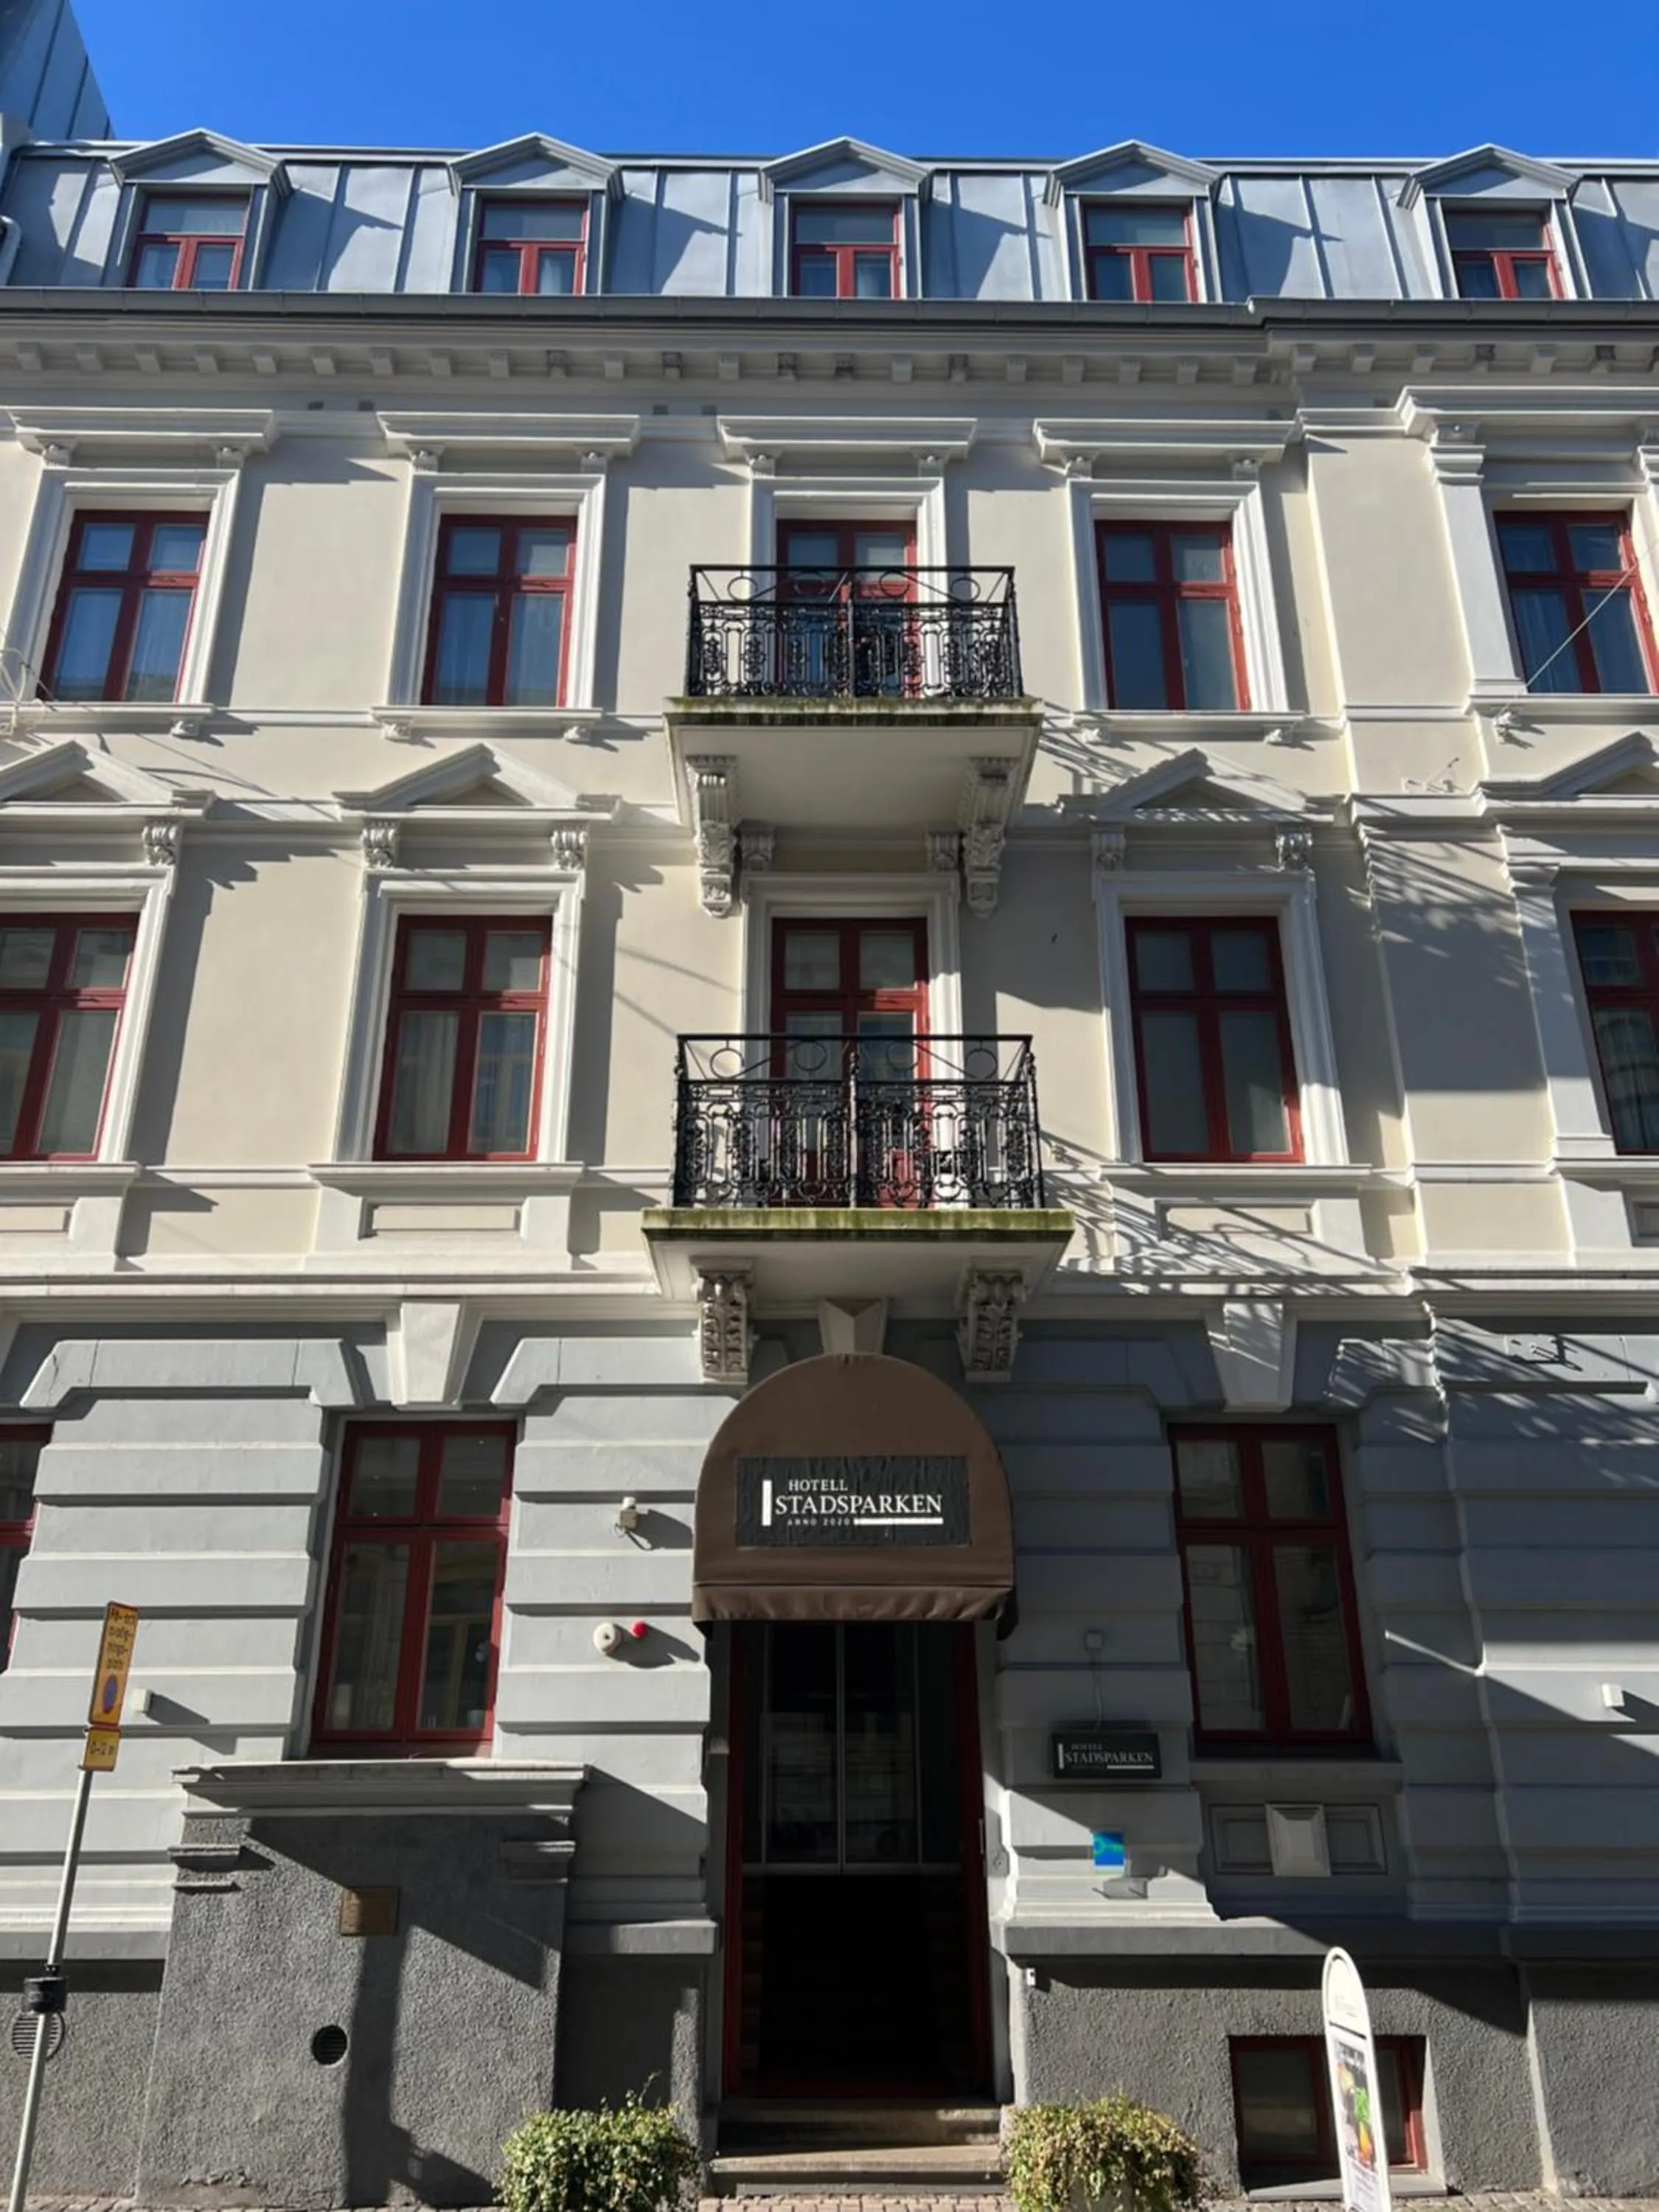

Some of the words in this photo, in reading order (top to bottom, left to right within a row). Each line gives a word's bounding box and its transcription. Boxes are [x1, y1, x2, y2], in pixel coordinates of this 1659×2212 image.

[787, 1478, 848, 1492] HOTELL
[775, 1494, 942, 1514] STADSPARKEN
[1065, 1750, 1154, 1764] STADSPARKEN
